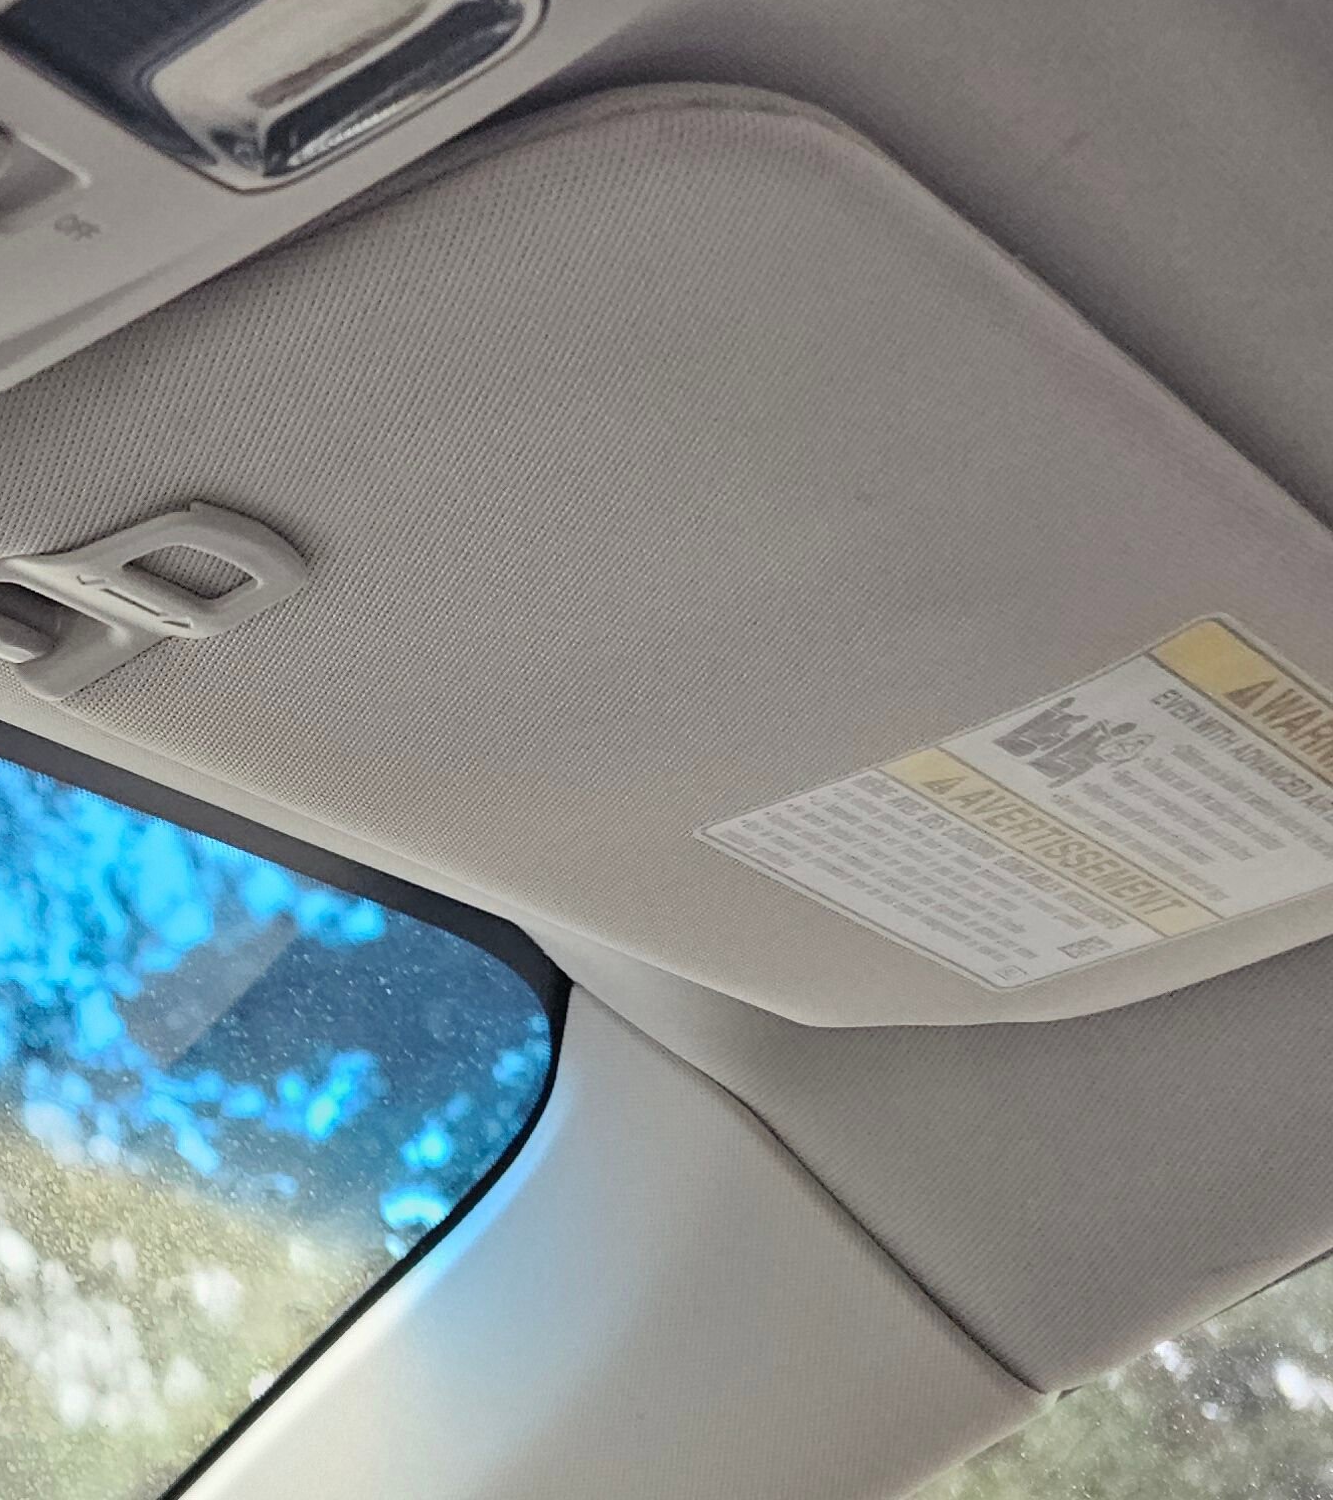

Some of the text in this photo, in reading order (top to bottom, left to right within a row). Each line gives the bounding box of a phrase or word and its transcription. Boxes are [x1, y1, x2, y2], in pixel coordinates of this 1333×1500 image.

[1150, 688, 1206, 725] EVEN
[1189, 715, 1240, 749] WITH
[947, 787, 1188, 915] AVERTISSEMENT
